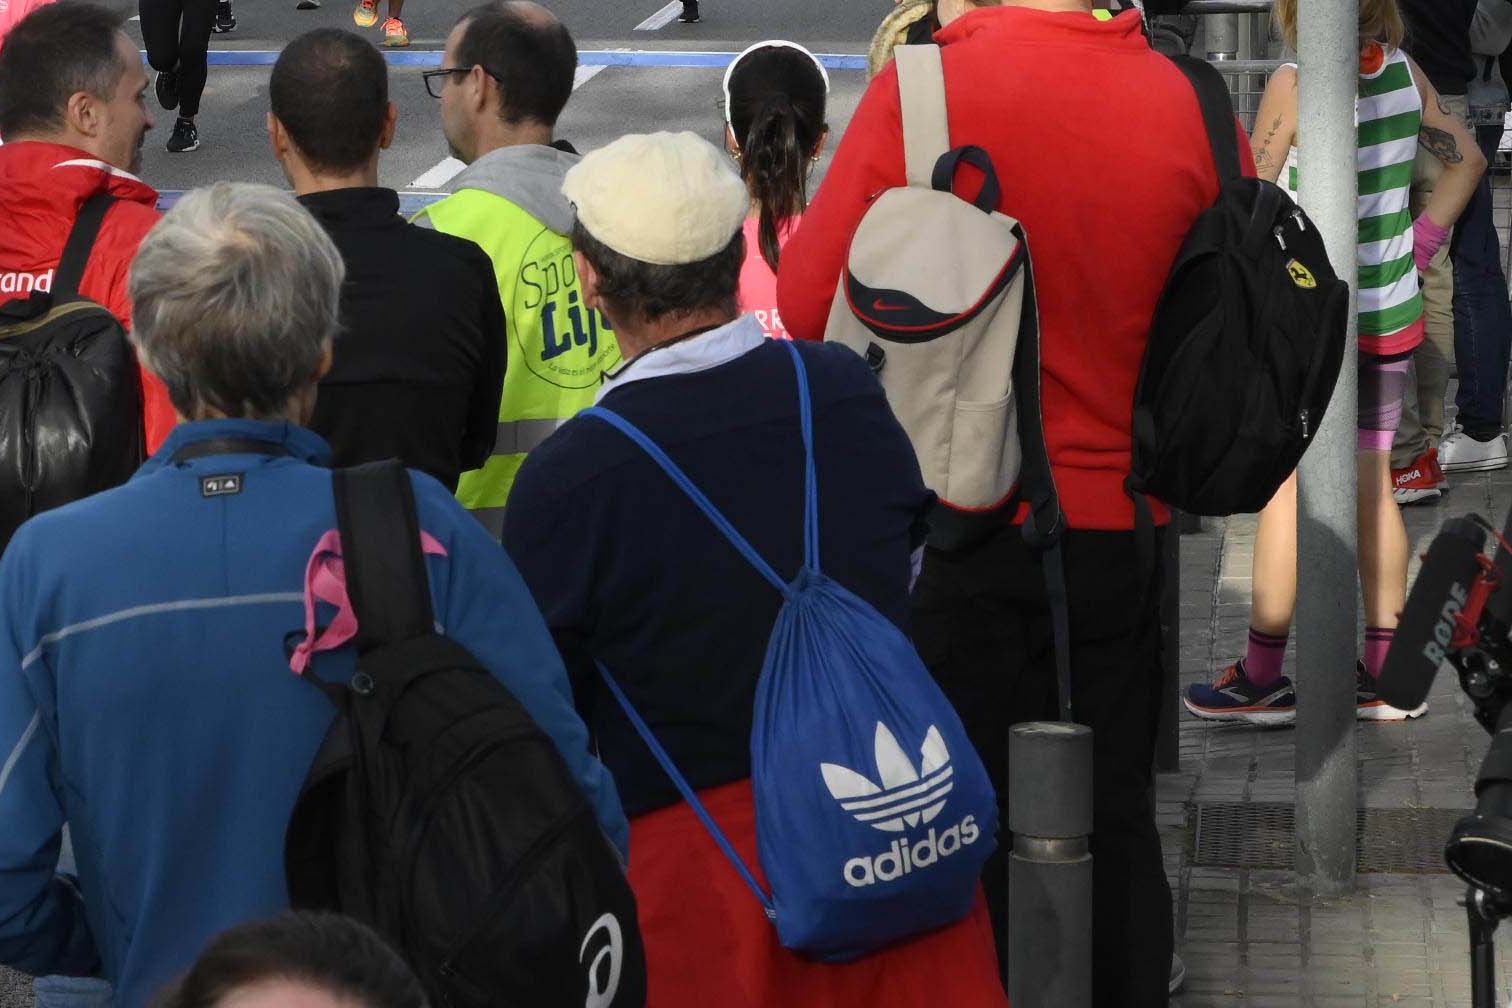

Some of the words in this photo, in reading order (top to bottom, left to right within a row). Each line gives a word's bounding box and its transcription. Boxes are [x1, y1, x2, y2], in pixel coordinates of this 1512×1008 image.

[521, 253, 576, 310] Spo
[1395, 468, 1421, 486] HOKA
[843, 814, 980, 887] adidas
